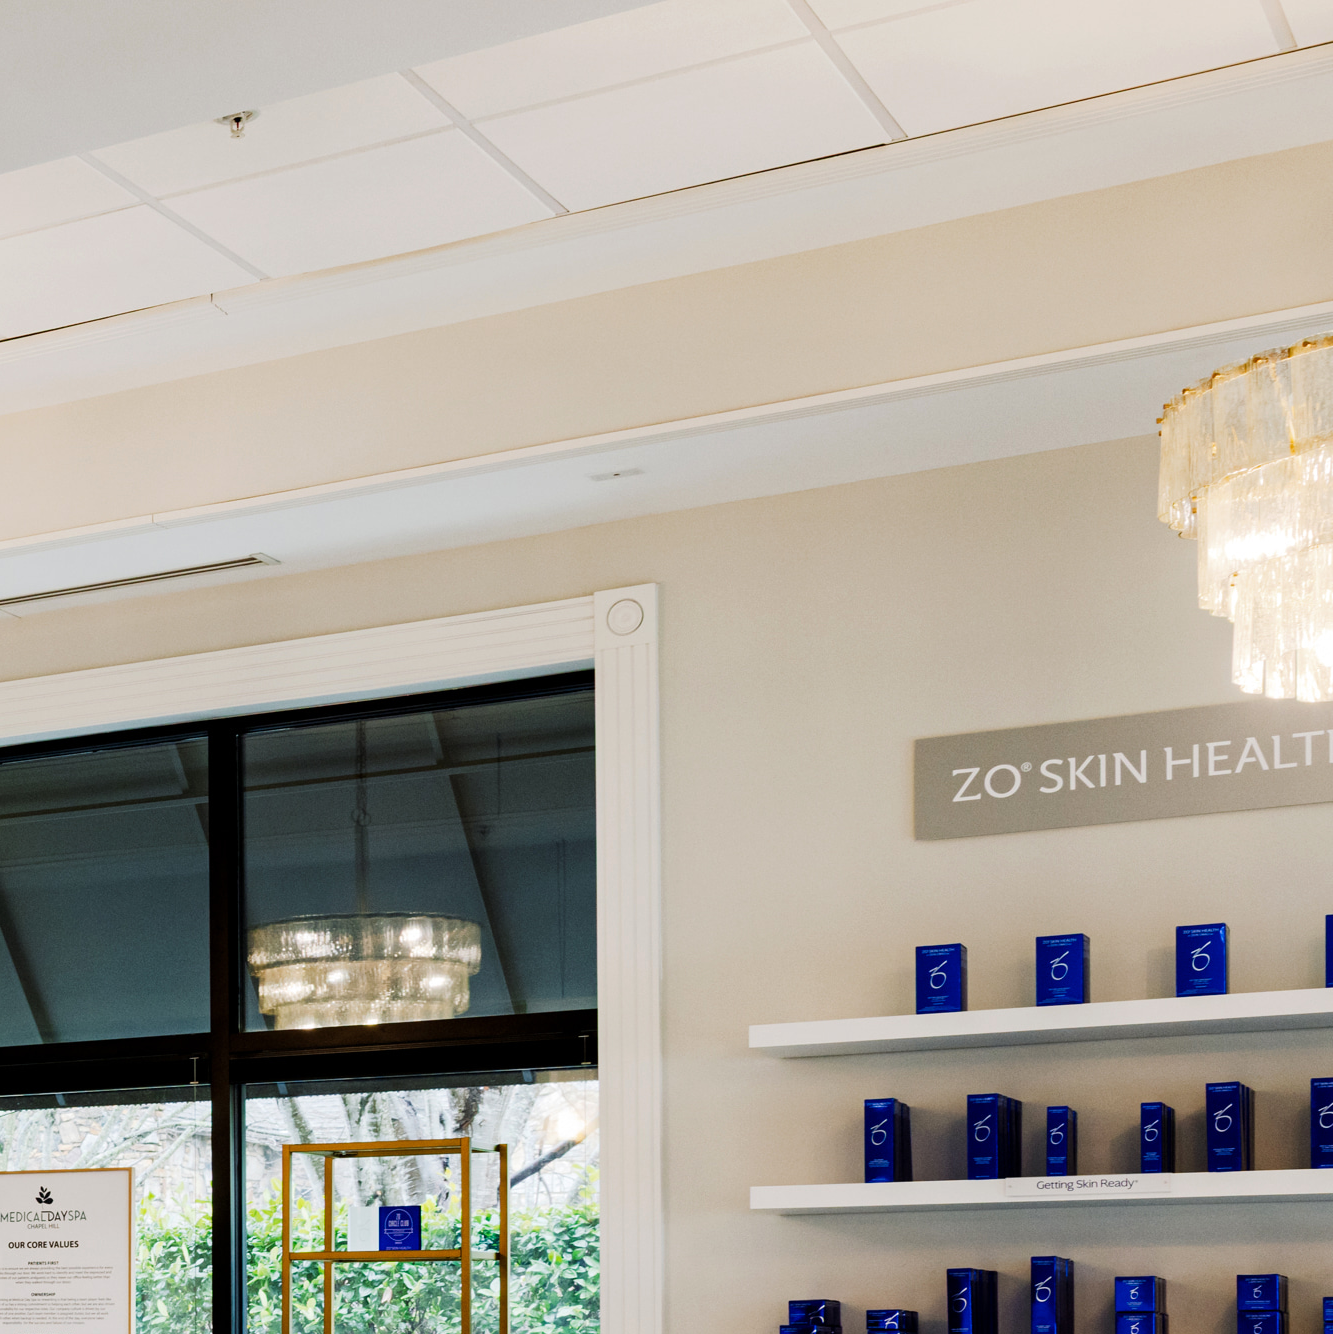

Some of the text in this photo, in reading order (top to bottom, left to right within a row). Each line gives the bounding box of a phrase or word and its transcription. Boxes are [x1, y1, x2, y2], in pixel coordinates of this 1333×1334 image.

[1039, 749, 1148, 794] SKIN
[1163, 729, 1333, 781] HEALT
[1036, 1180, 1074, 1191] Getting
[1076, 1179, 1098, 1189] Skin
[8, 1240, 79, 1249] OUR CORE VALUES
